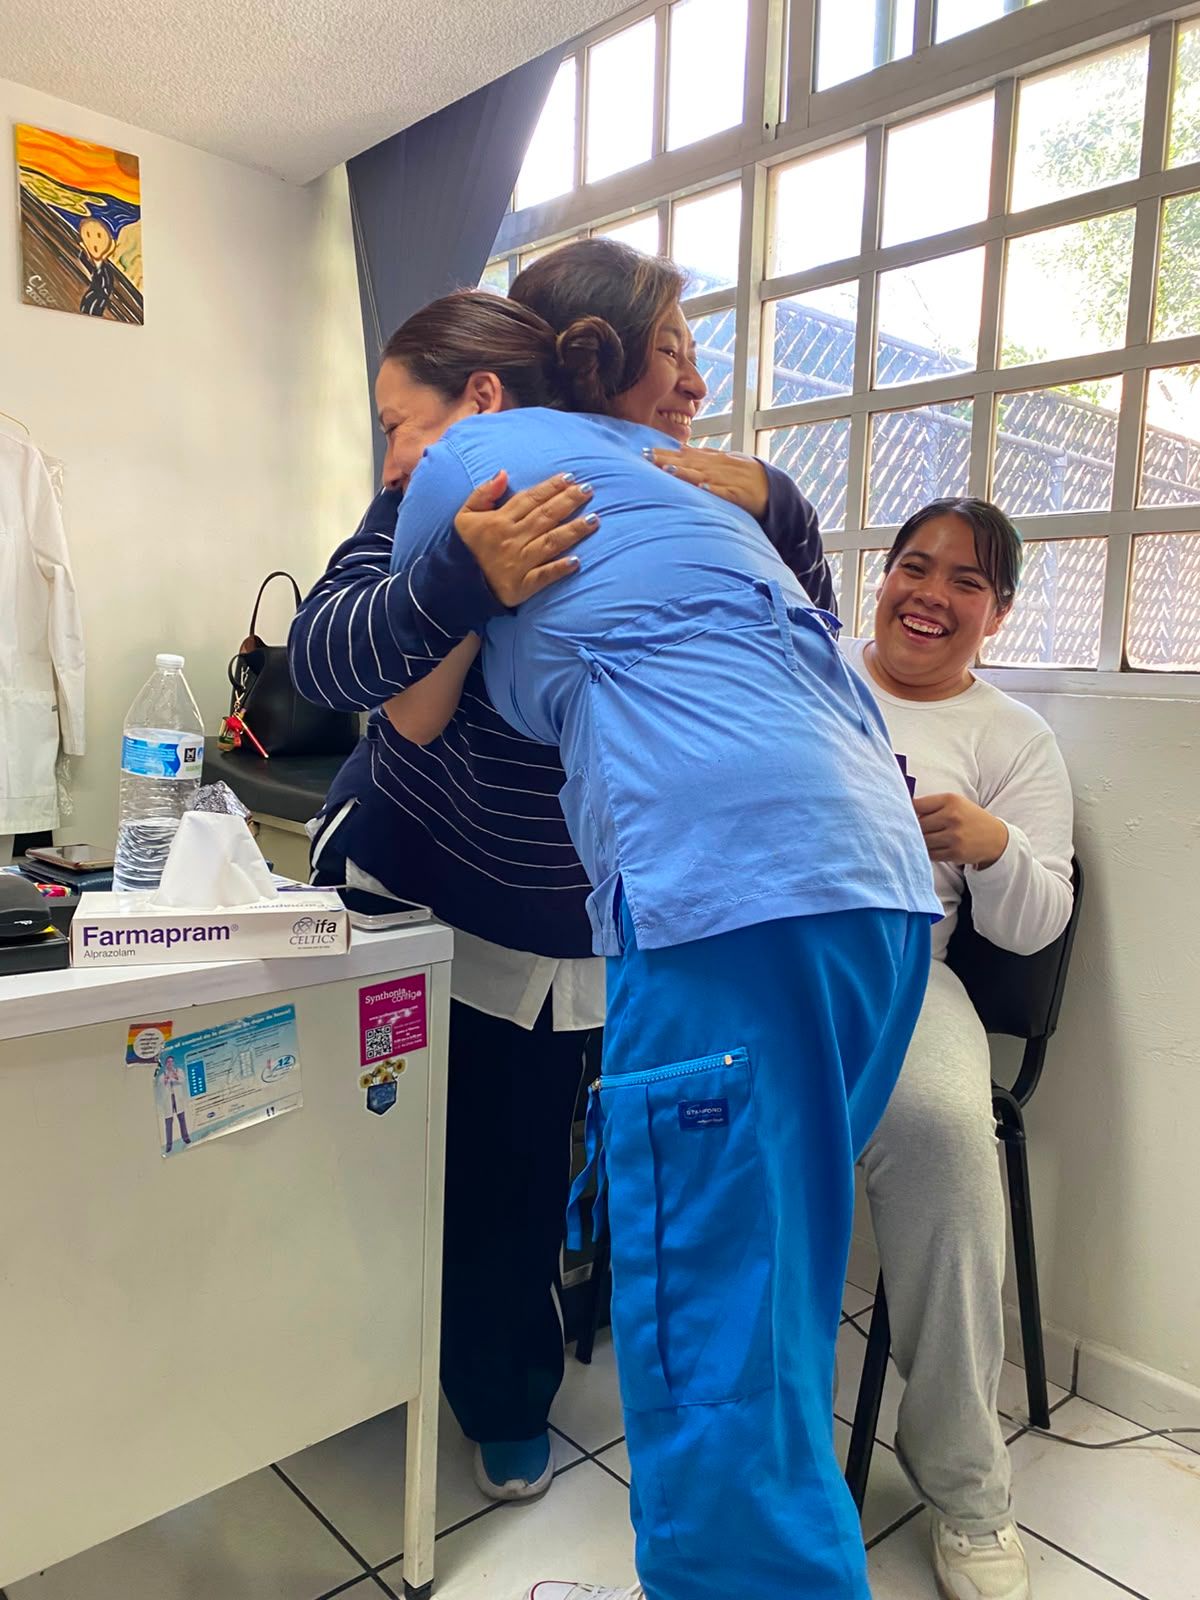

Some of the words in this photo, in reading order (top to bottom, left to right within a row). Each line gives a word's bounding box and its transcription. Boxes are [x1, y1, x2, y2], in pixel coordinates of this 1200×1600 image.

[314, 919, 337, 934] ifa
[289, 934, 336, 946] CELTICS
[84, 948, 136, 959] Alprazolam
[365, 988, 406, 1004] Synthonia
[277, 1055, 291, 1068] 12
